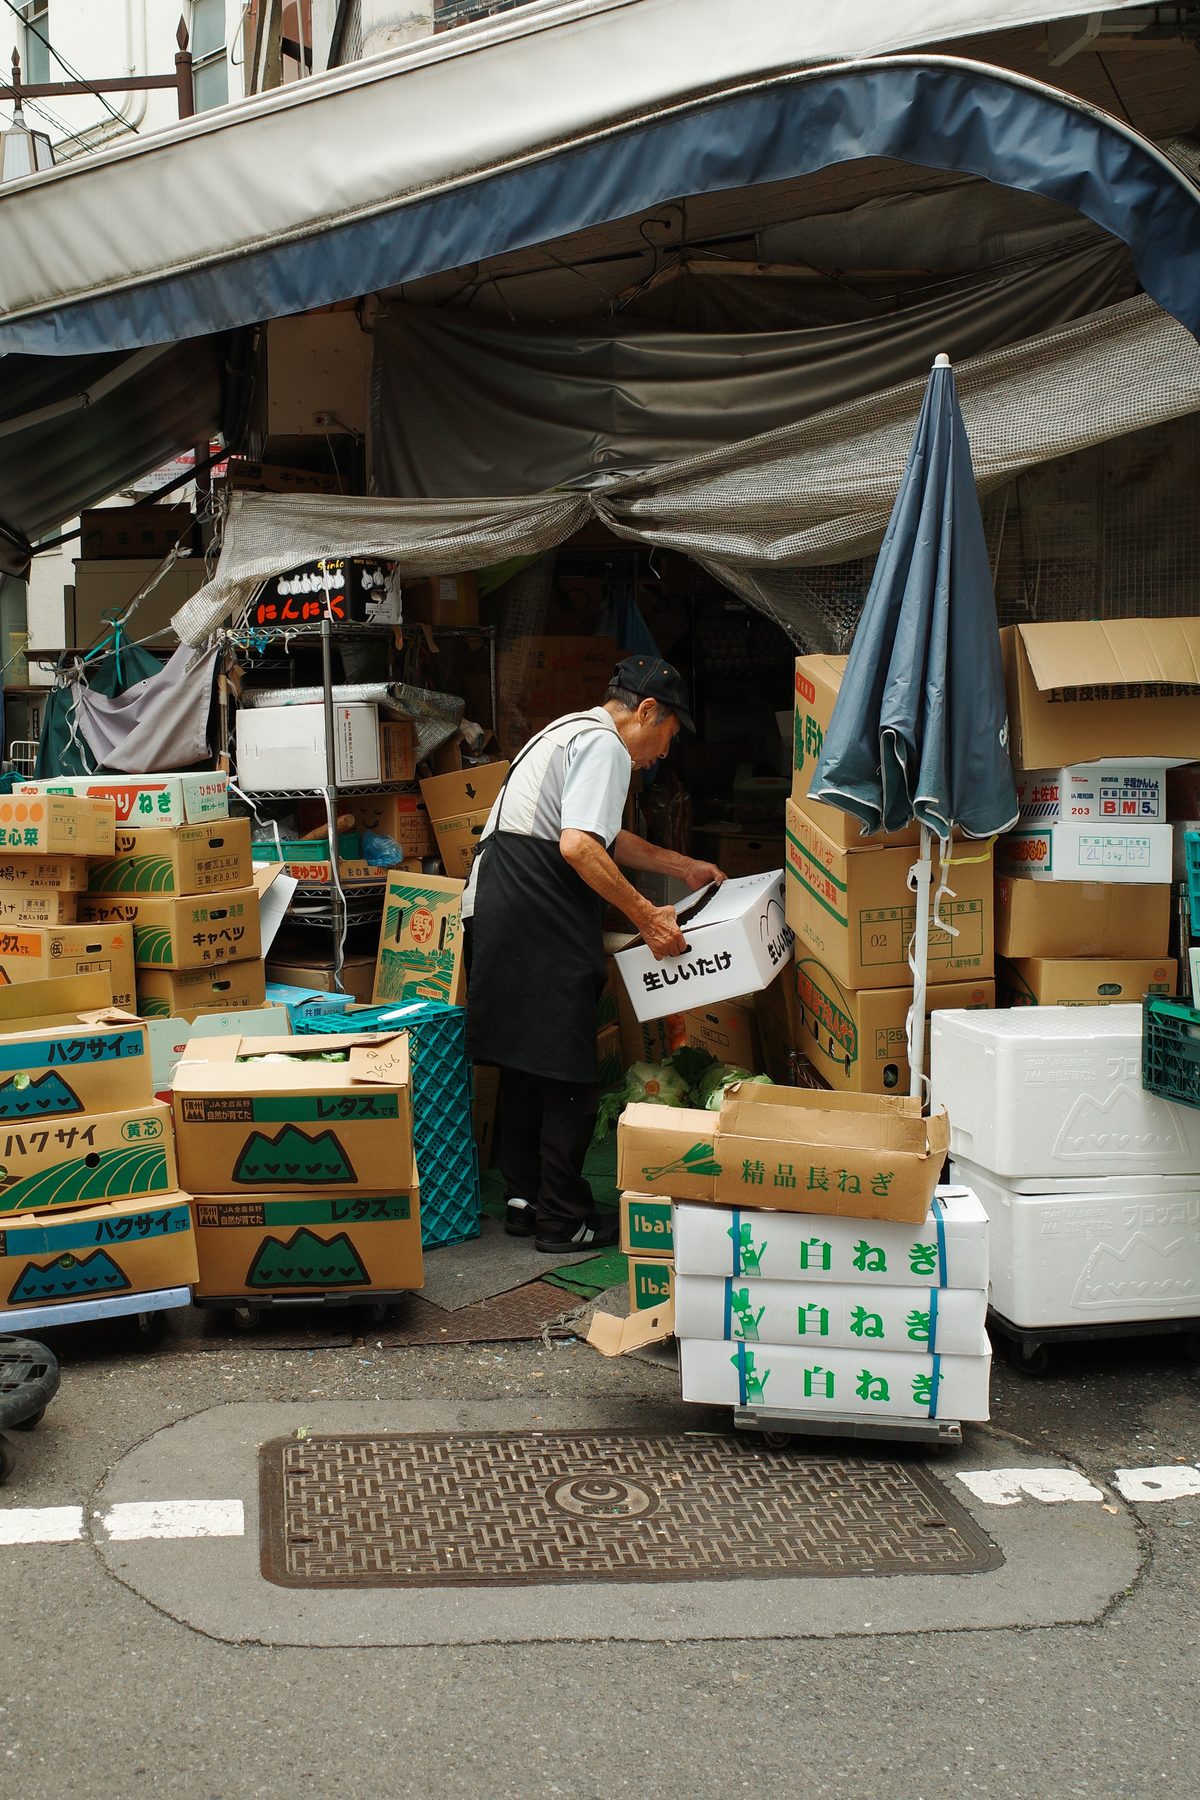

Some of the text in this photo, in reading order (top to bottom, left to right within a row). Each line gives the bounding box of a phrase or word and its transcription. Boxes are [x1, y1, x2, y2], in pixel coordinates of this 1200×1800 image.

[317, 559, 345, 570] Sinko
[257, 595, 345, 624] にんにく
[1071, 807, 1090, 815] 203
[1104, 801, 1116, 814] B
[1122, 801, 1136, 814] M
[291, 864, 329, 883] きゅうり
[82, 906, 138, 921] キャベツ
[864, 910, 898, 921] 生産者
[956, 903, 977, 913] 数量
[192, 926, 245, 946] キャベツ
[870, 934, 888, 947] 02
[202, 945, 238, 960] 長野県
[643, 951, 732, 992] 生しいたけ
[112, 993, 131, 1004] あさま
[47, 1035, 142, 1063] ハクサイです。
[207, 1110, 252, 1120] 自然が育てた
[316, 1097, 397, 1118] レタスです。
[126, 1120, 158, 1139] 黄芯
[4, 1124, 98, 1157] ハクサイ
[741, 1158, 895, 1197] 精品長ねぎ
[220, 1215, 264, 1225] 自然が育てた
[331, 1200, 408, 1221] レタスです。
[95, 1211, 188, 1241] ハクサイです。
[800, 1237, 939, 1275] 白ねぎ
[798, 1303, 939, 1342] 白ねぎ
[803, 1366, 944, 1405] 白ねぎ
